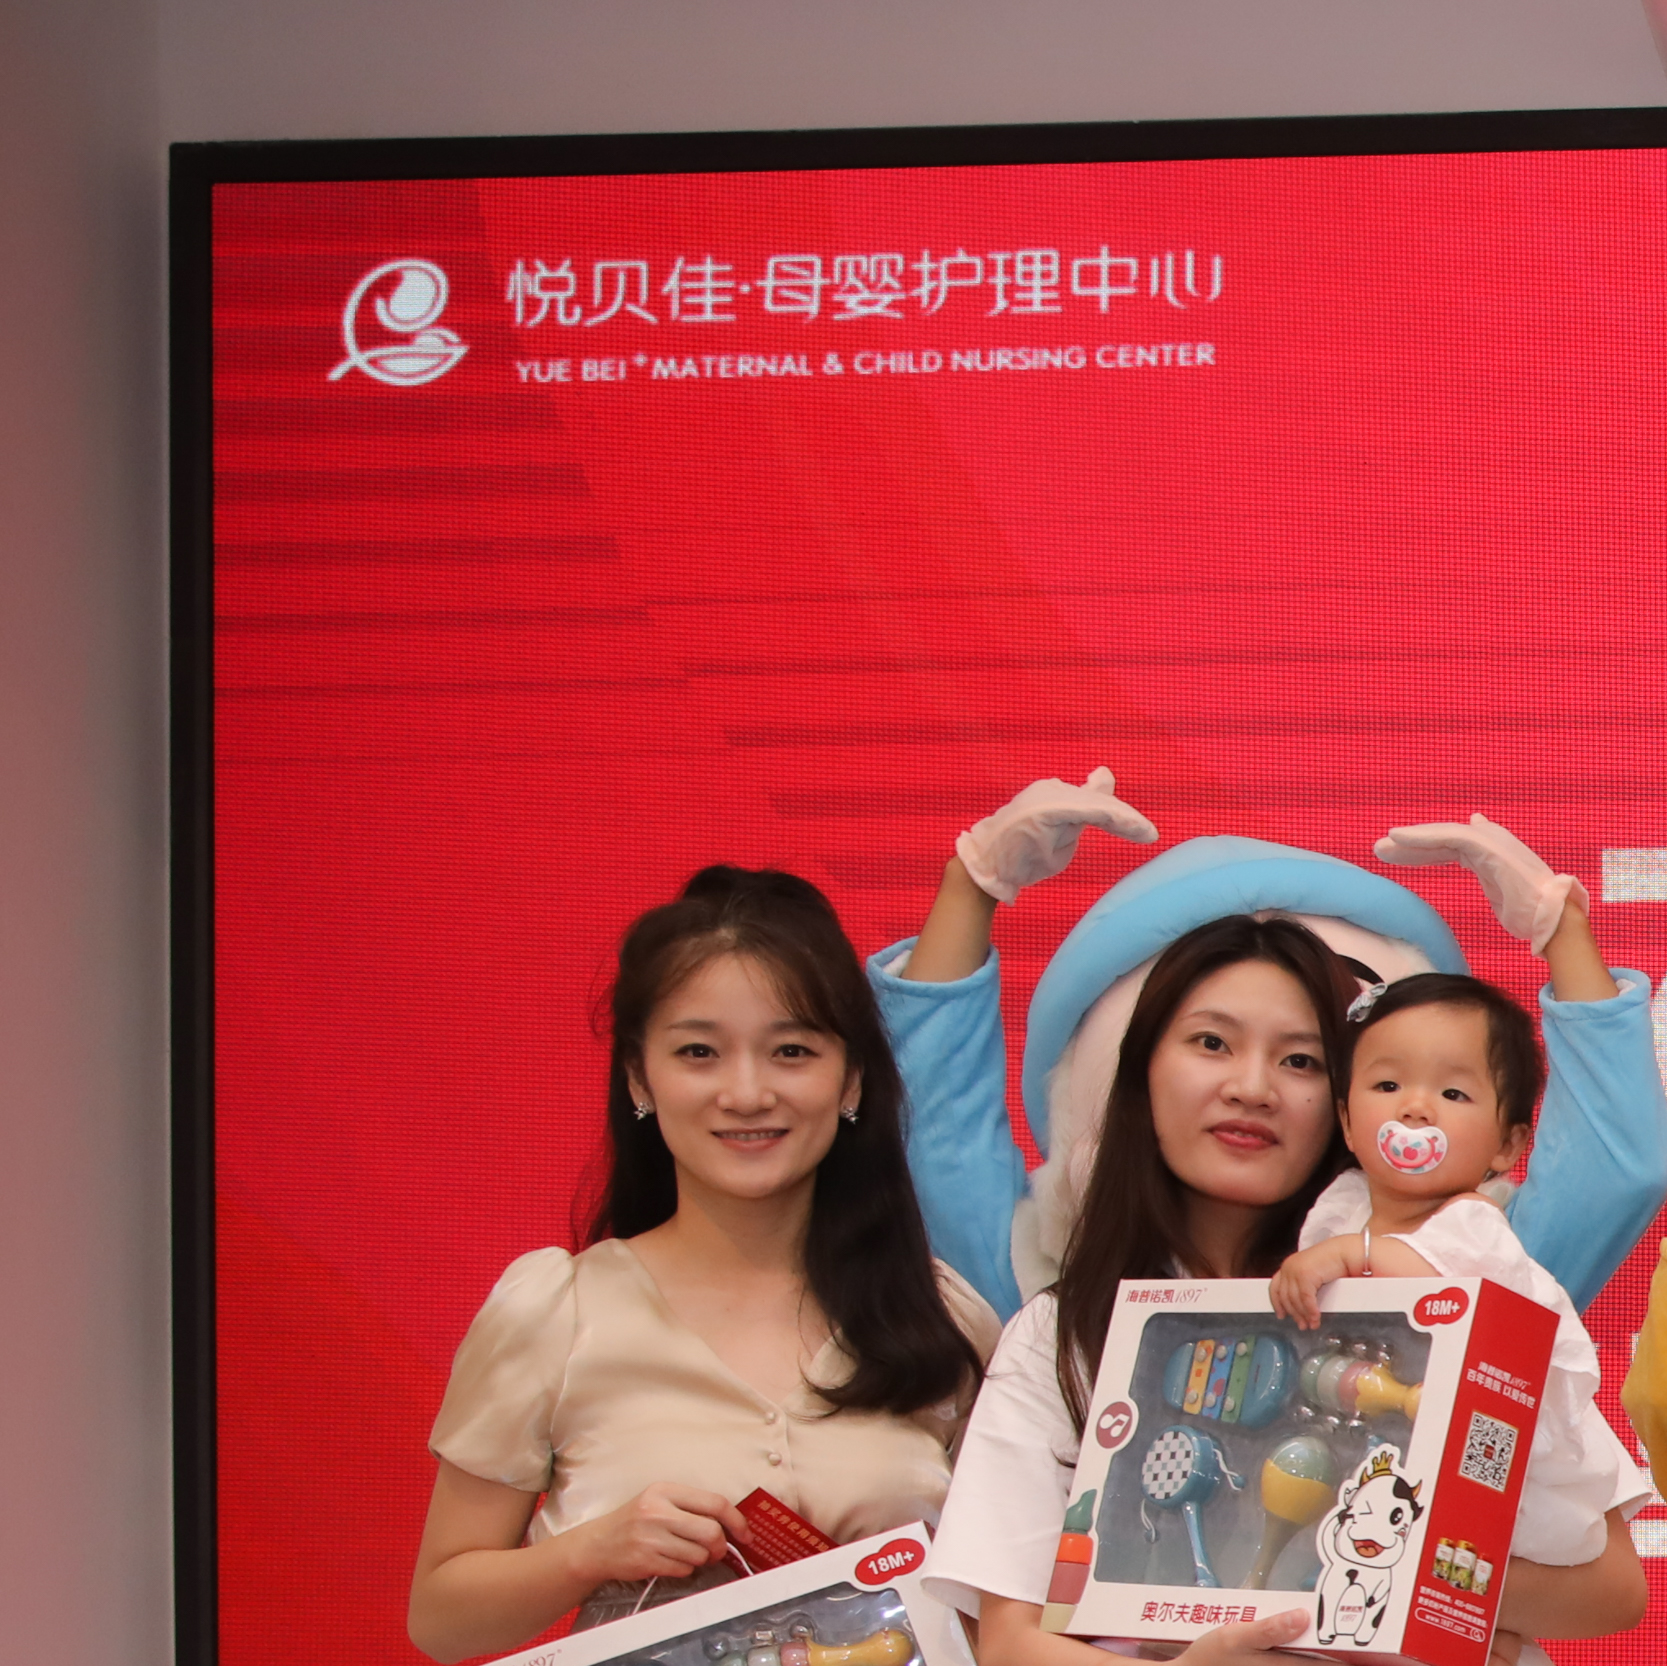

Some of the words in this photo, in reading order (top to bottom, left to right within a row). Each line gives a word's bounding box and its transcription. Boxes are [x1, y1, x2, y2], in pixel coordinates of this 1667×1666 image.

[506, 245, 1223, 328] 悦贝佳·母婴护理中心
[516, 359, 573, 383] YUE
[652, 353, 813, 380] MATERNAL
[822, 353, 845, 375] &
[853, 350, 943, 374] CHILD
[951, 346, 1087, 372] NURSING
[1095, 342, 1216, 368] CENTER
[1424, 1299, 1461, 1316] 18M+
[867, 1550, 915, 1576] 18M+
[1140, 1600, 1258, 1625] 奥尔夫趣味玩具
